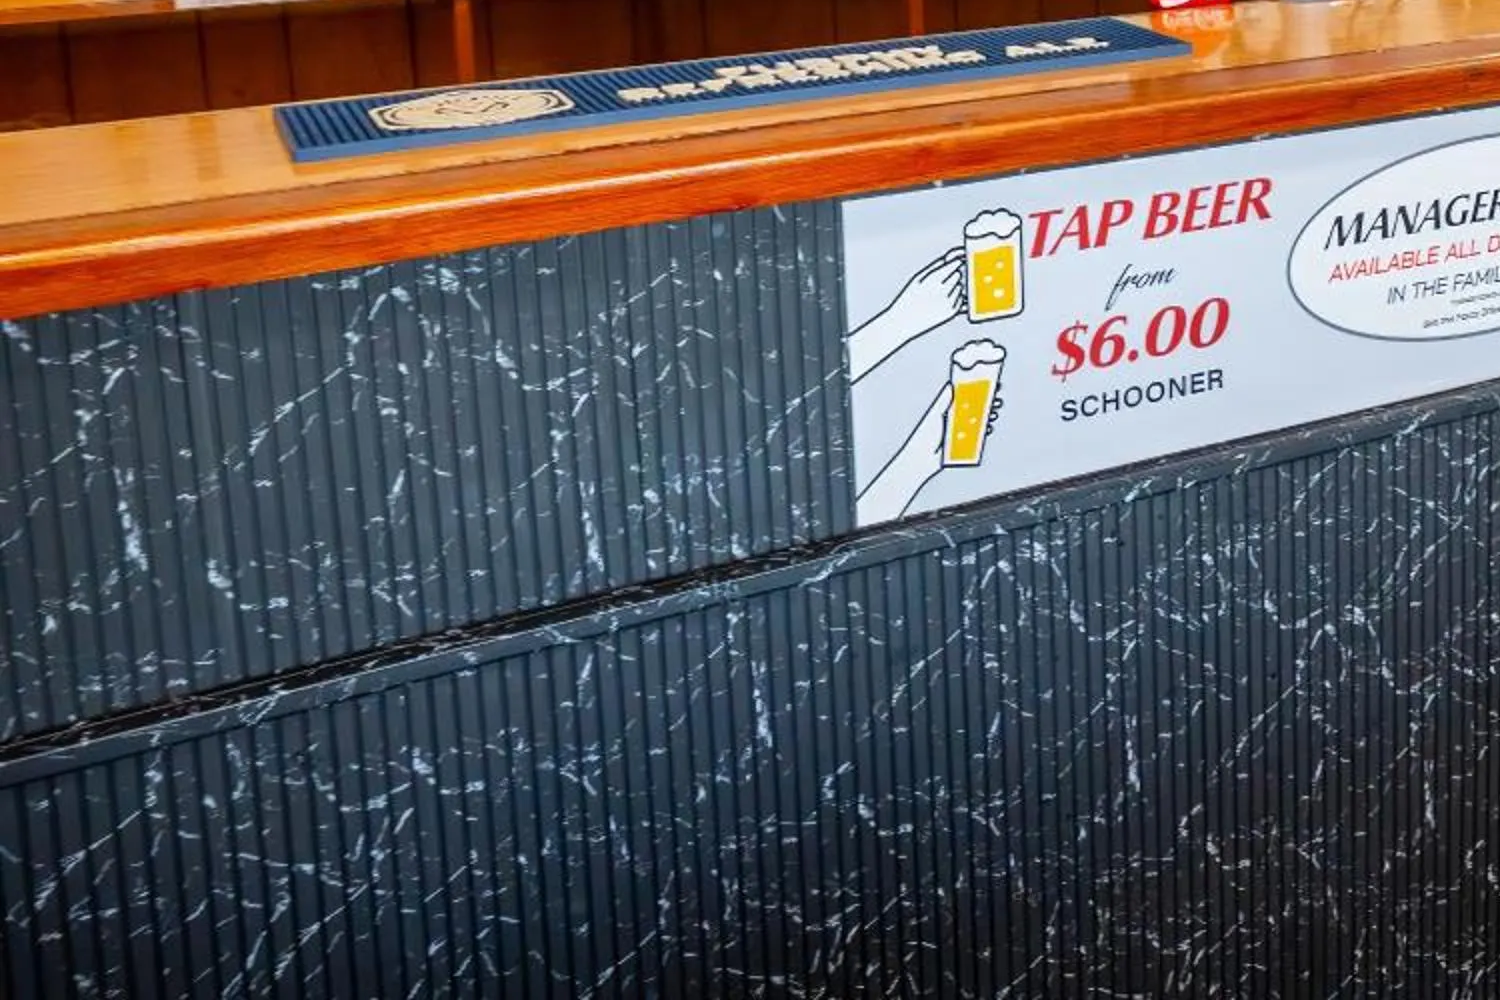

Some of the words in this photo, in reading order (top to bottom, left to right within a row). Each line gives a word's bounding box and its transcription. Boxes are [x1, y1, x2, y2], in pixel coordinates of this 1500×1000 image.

[1028, 200, 1134, 259] TAP
[1143, 176, 1275, 241] BEER
[1327, 245, 1440, 283] AVAILABLE
[1443, 238, 1480, 265] ALL
[1106, 263, 1178, 311] from
[1386, 286, 1407, 305] IN
[1411, 276, 1449, 299] THE
[1051, 297, 1231, 382] $6.00
[1060, 368, 1225, 422] SCHOONER
